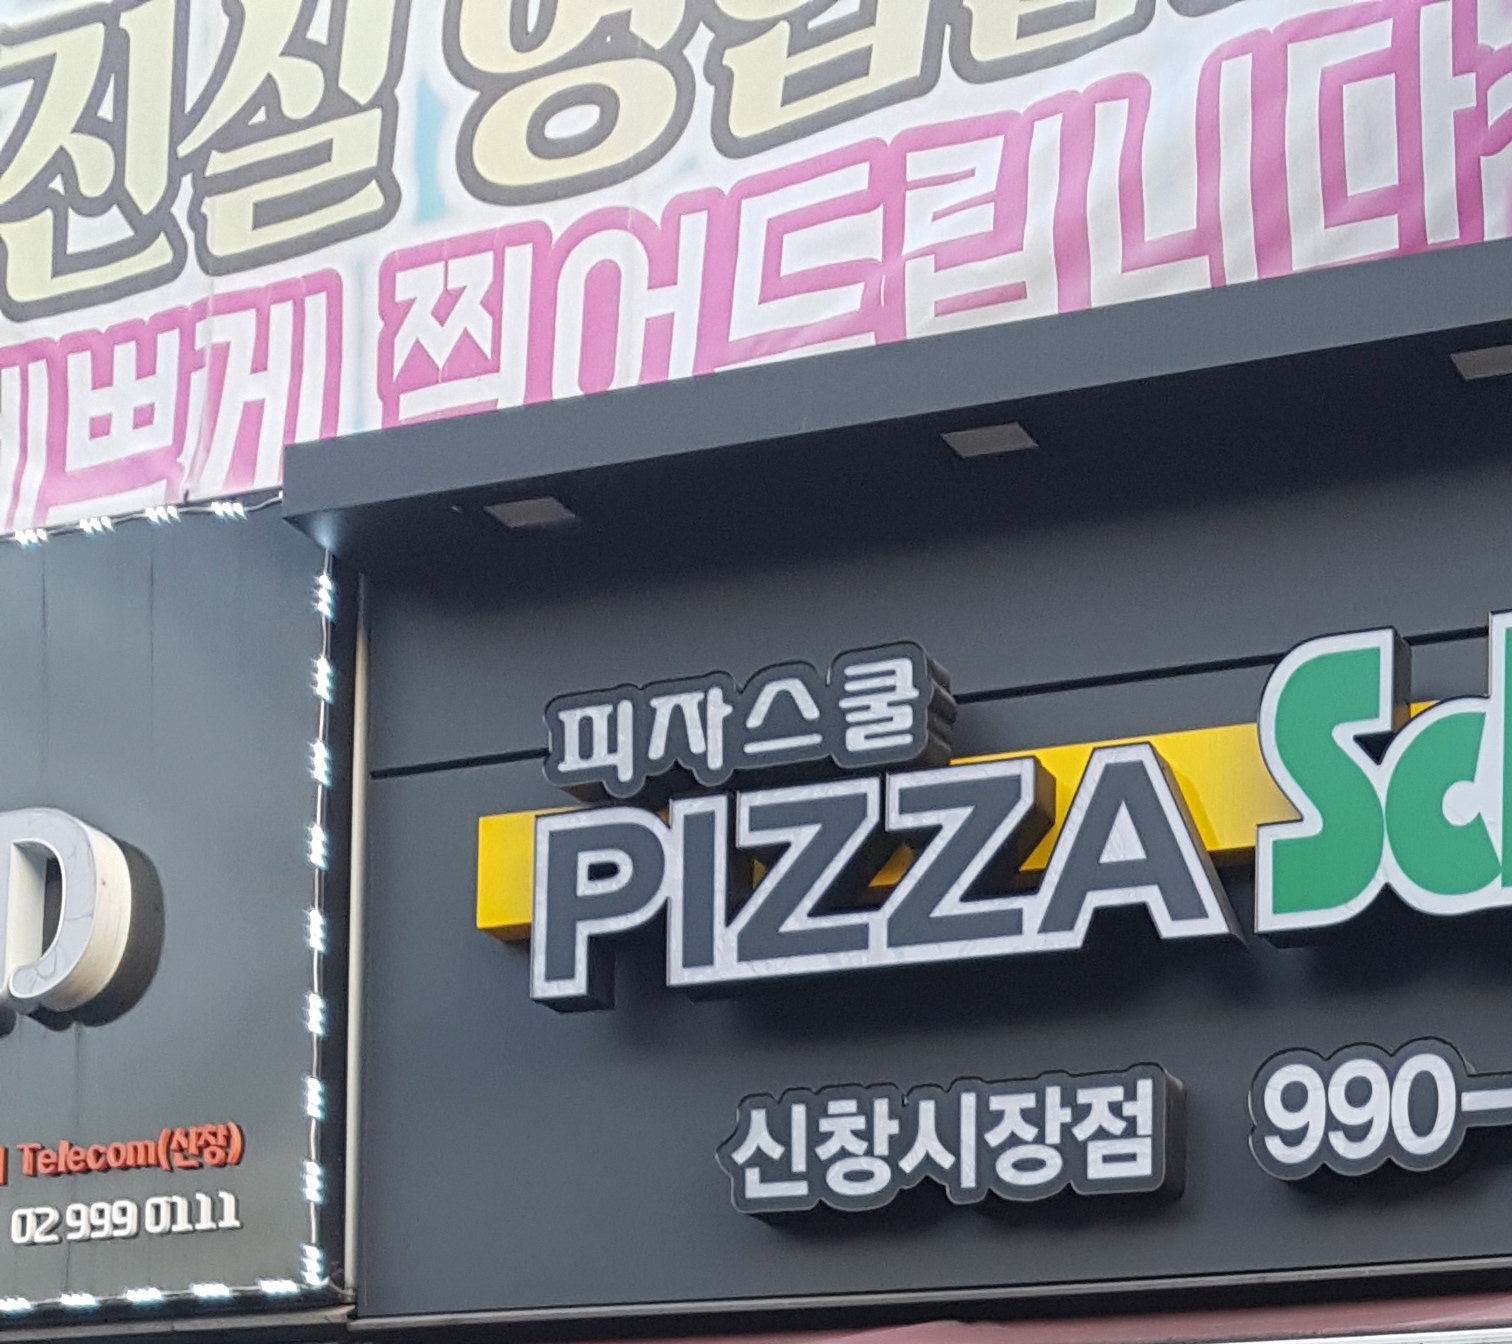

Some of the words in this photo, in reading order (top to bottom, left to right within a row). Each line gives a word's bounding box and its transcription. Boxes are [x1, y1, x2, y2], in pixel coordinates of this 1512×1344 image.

[556, 657, 918, 783] 피자스쿨
[530, 740, 1232, 1000] PIZZA
[731, 1077, 1155, 1200] 신창시장점
[11, 1205, 60, 1244] 02
[66, 1201, 138, 1240] 999
[145, 1191, 241, 1233] 0111
